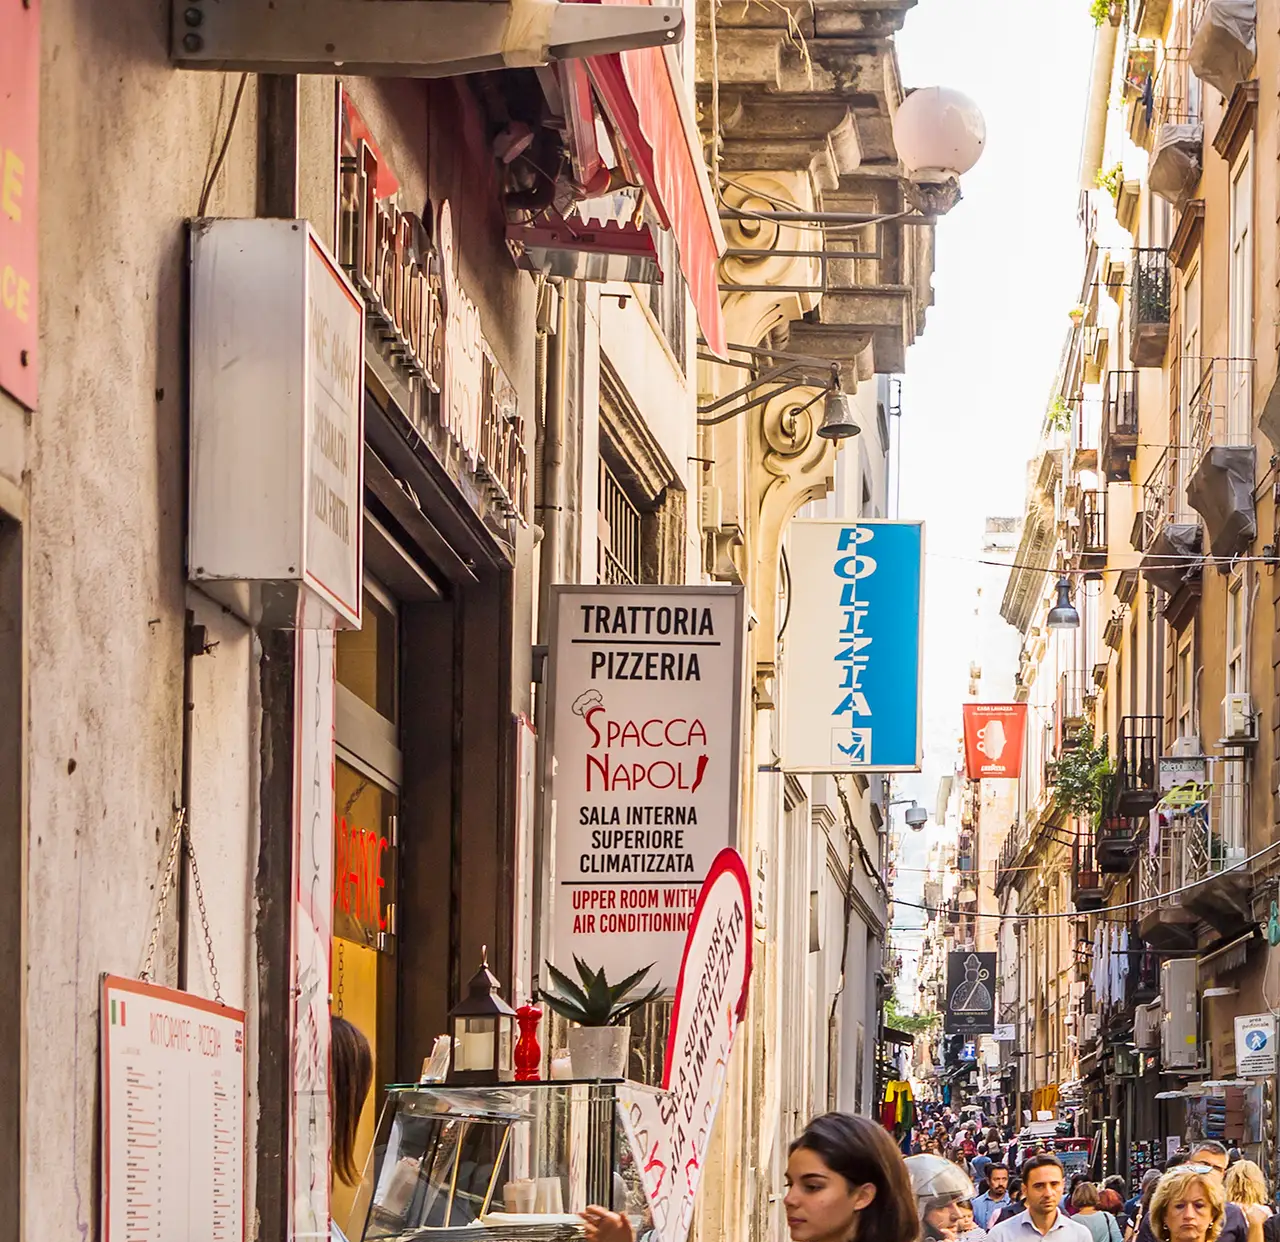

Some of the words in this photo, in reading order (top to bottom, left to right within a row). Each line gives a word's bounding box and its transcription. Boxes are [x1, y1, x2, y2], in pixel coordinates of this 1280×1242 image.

[580, 605, 714, 636] TRATTORIA
[831, 527, 878, 716] POLIZIA
[591, 651, 701, 681] PIZZERIA
[585, 705, 707, 748] SPACCA
[585, 753, 709, 794] NAPOLI
[579, 806, 621, 826] SALA
[626, 806, 698, 825] INTERNA
[591, 830, 684, 850] SUPERIORE
[579, 853, 695, 873] CLIMATIZZATA
[572, 890, 616, 910] UPPER
[620, 889, 659, 909] ROOM
[663, 888, 697, 908] WITH
[573, 915, 596, 933] AIR
[684, 907, 727, 1066] SUPERIORE
[684, 900, 744, 1124] CLIMATIZZATA
